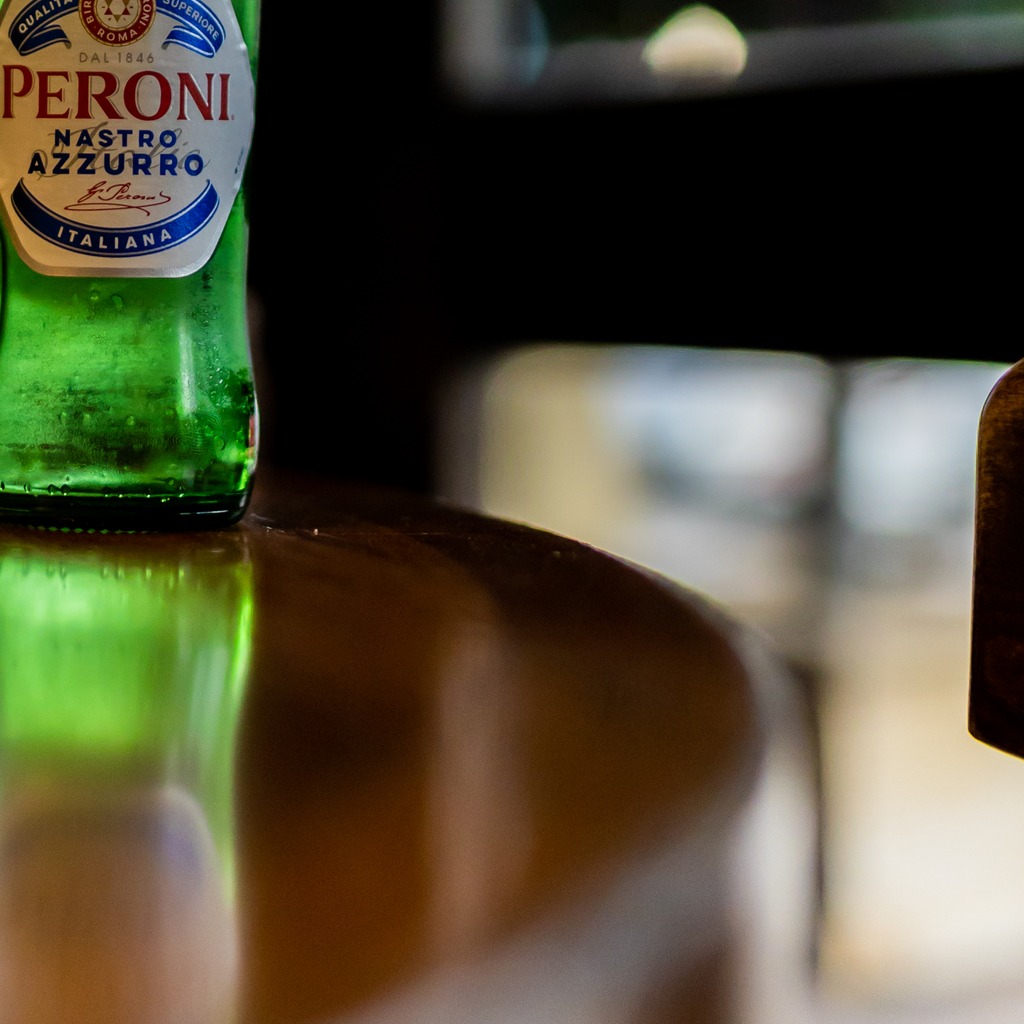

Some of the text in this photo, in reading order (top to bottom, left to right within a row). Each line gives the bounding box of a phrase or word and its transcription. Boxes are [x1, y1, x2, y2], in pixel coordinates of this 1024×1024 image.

[97, 28, 138, 42] ROMA
[79, 52, 155, 64] DAL 1846
[2, 64, 232, 122] PERONI
[54, 128, 177, 149] NASTRO
[27, 152, 205, 177] AZZURRO
[57, 226, 173, 250] ITALIANA
